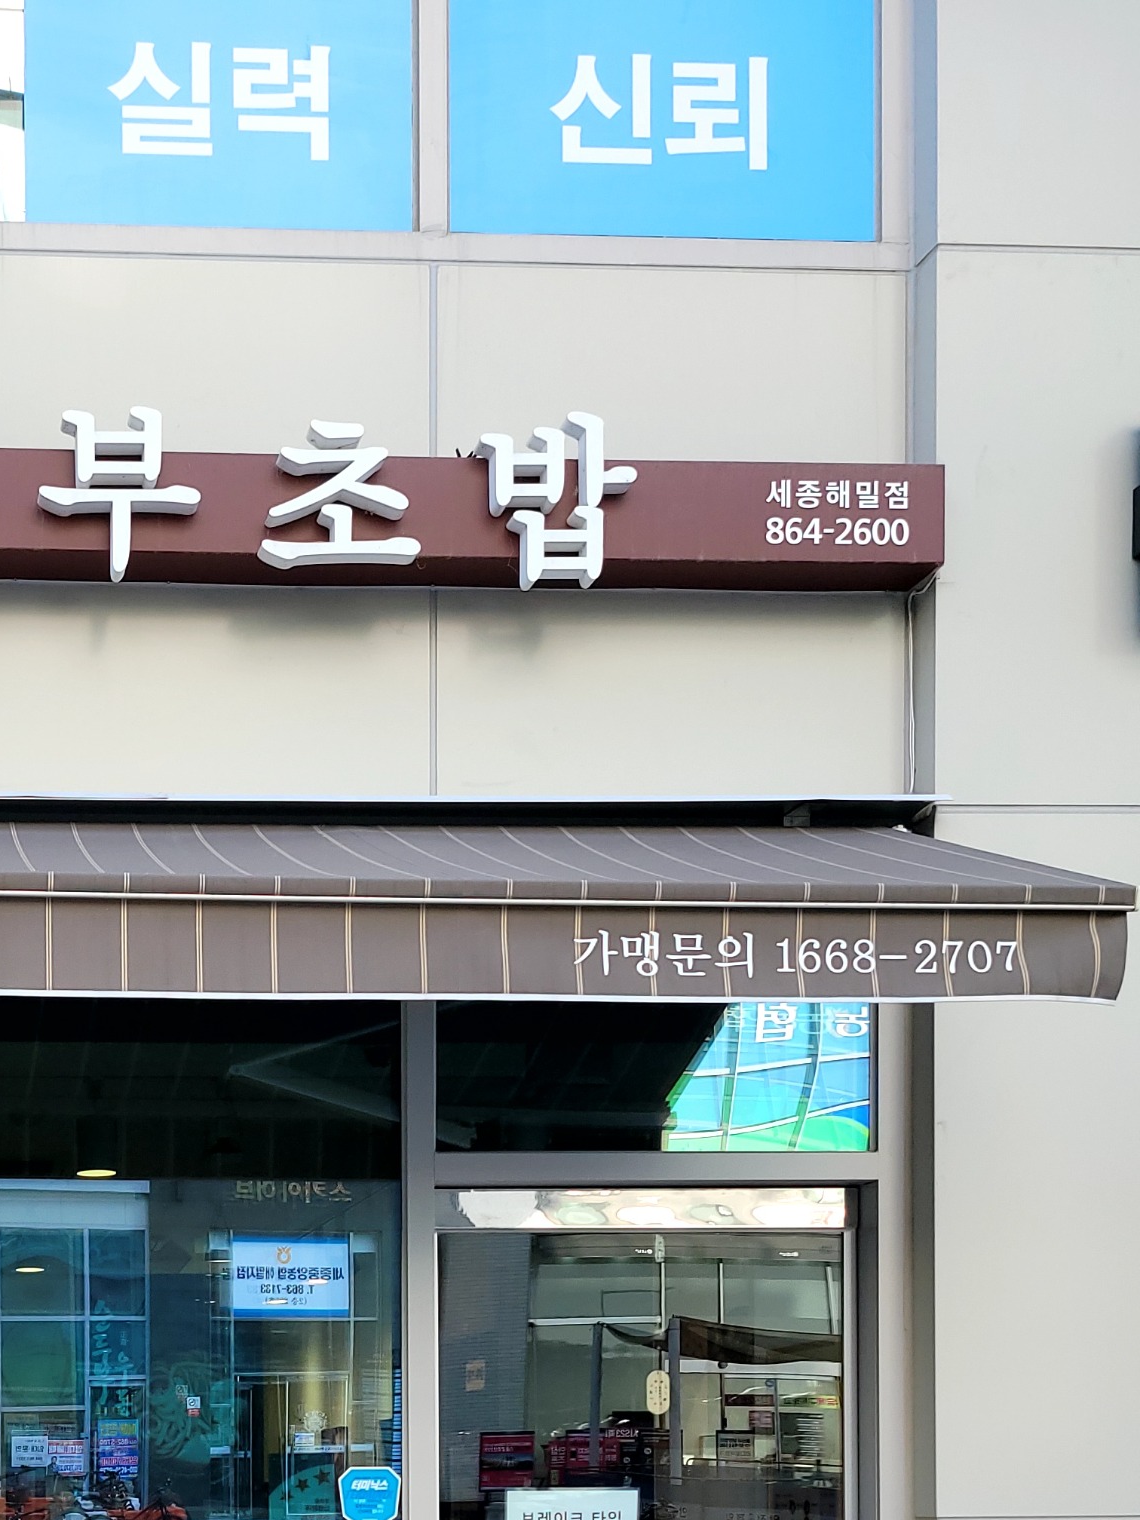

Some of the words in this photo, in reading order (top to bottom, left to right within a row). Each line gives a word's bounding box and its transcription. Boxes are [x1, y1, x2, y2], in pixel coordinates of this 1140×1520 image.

[109, 41, 333, 161] 실력
[550, 53, 769, 172] 신뢰
[765, 479, 910, 511] 세종해밀점
[765, 516, 910, 548] 864-2600
[573, 930, 755, 977] 가맹문의
[776, 938, 1019, 975] 1668-2707
